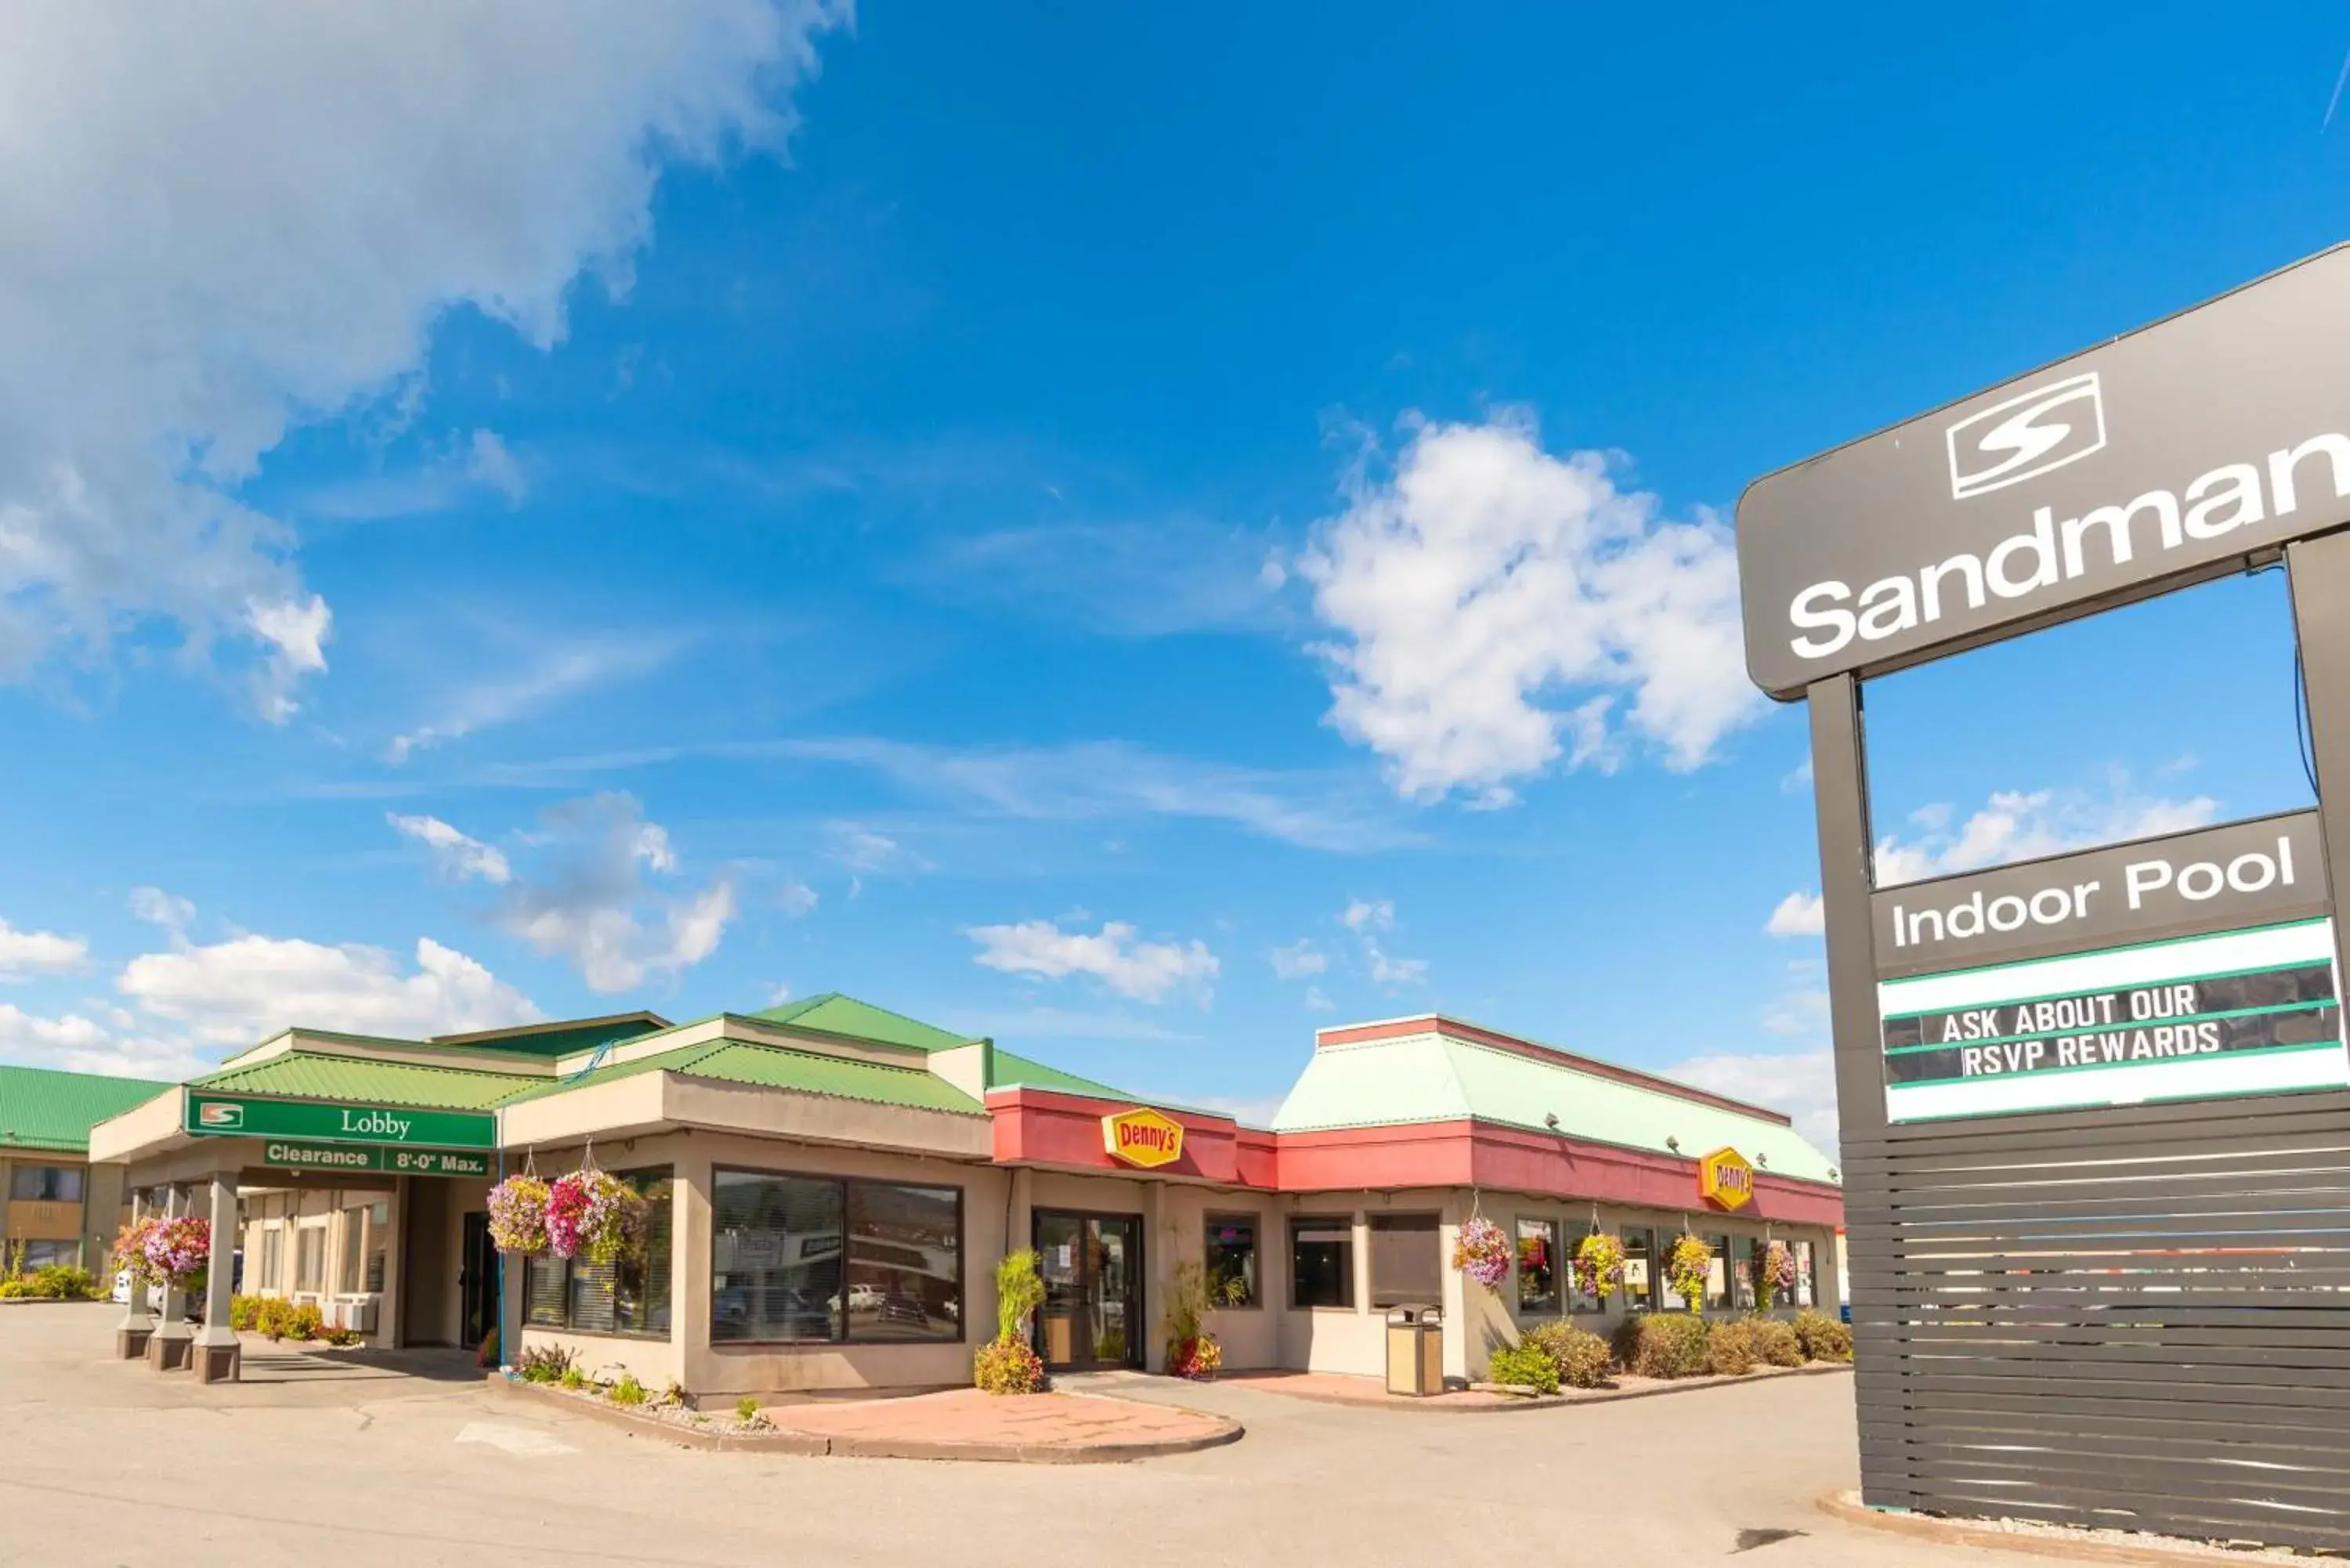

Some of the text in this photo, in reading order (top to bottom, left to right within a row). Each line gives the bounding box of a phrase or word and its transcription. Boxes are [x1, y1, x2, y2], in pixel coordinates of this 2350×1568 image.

[1789, 432, 2350, 659] Sandman
[1893, 836, 2295, 947] Indoor Pool
[1943, 983, 2196, 1043] ASK ABOUT OUR
[1963, 1021, 2220, 1077] RSVP REWARDS
[341, 1110, 411, 1139] Lobby
[1119, 1122, 1176, 1151] Denny's
[267, 1143, 369, 1166] Clearance
[440, 1155, 485, 1172] Max.
[1716, 1165, 1751, 1194] Denny's
